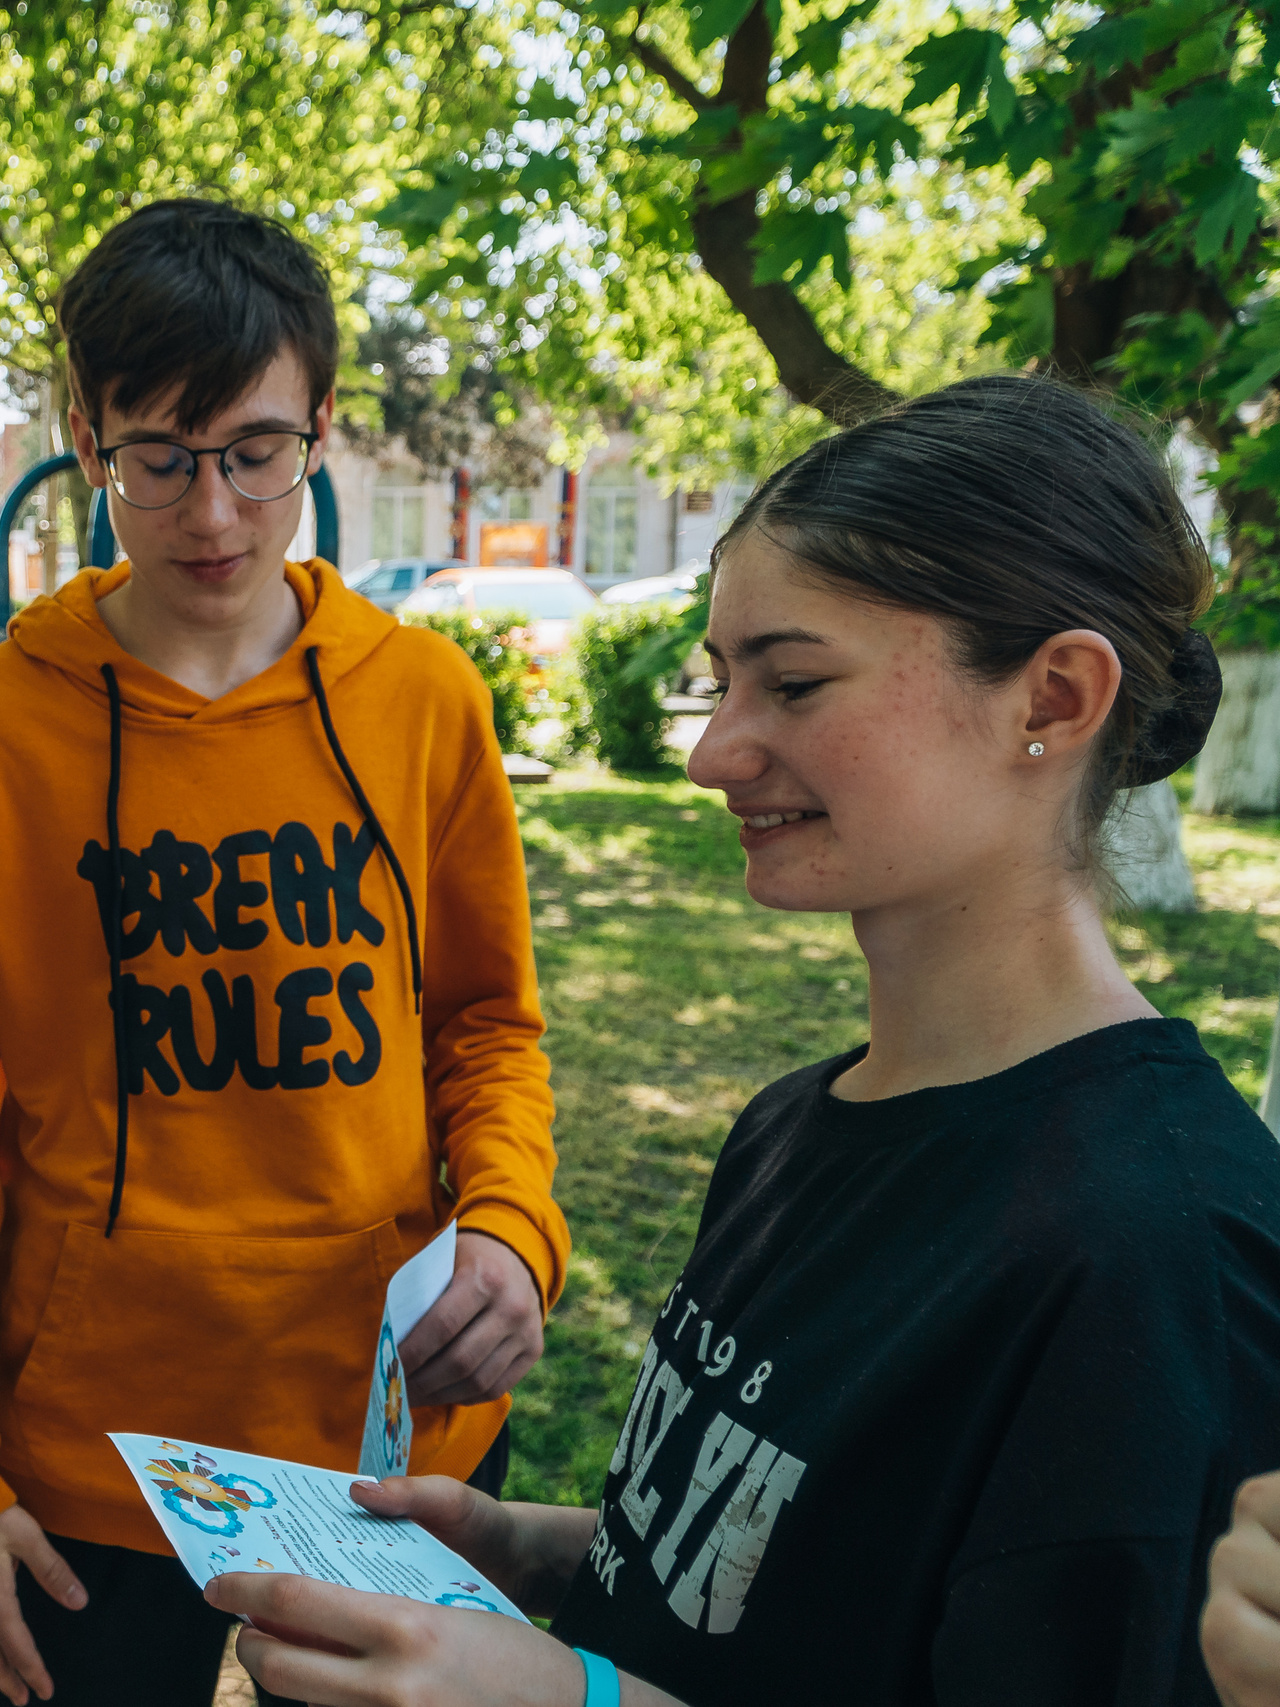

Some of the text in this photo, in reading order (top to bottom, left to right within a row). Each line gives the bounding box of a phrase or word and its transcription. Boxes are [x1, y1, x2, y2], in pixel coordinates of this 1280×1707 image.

[77, 822, 385, 960] BREAK
[109, 962, 382, 1096] RULES
[589, 1526, 625, 1596] RK
